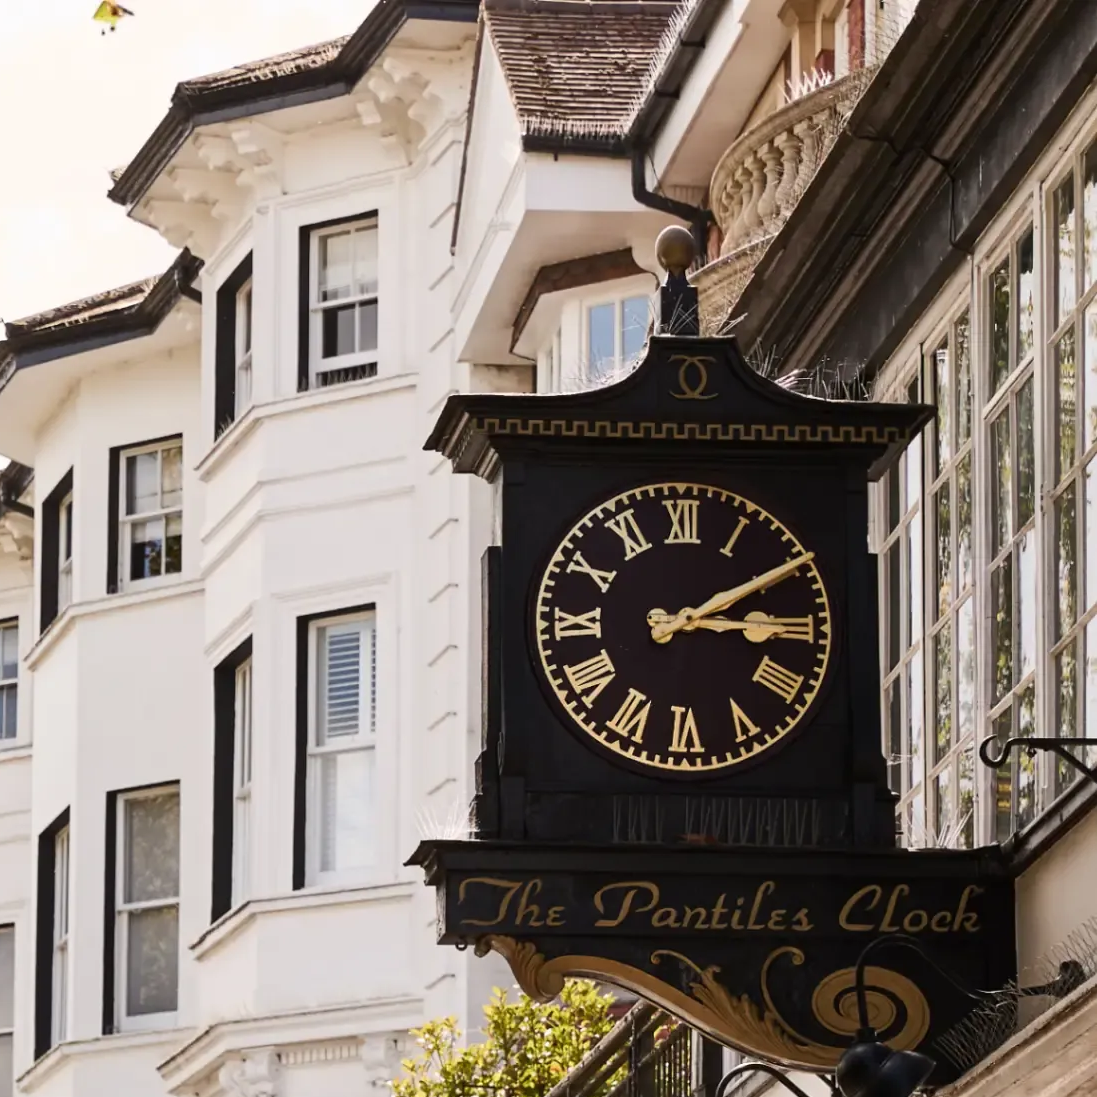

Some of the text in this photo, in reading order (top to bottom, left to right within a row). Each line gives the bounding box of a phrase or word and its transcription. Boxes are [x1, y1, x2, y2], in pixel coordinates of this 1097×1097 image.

[604, 508, 653, 561] XI
[661, 499, 702, 545] XII
[719, 516, 750, 557] I
[566, 551, 617, 593] X
[554, 606, 602, 641] IX
[563, 649, 616, 709] VIII
[752, 655, 805, 705] IIII
[605, 687, 653, 744] VII
[668, 705, 705, 752] VI
[729, 697, 761, 743] V
[457, 876, 985, 934] The Pantiles Clock
